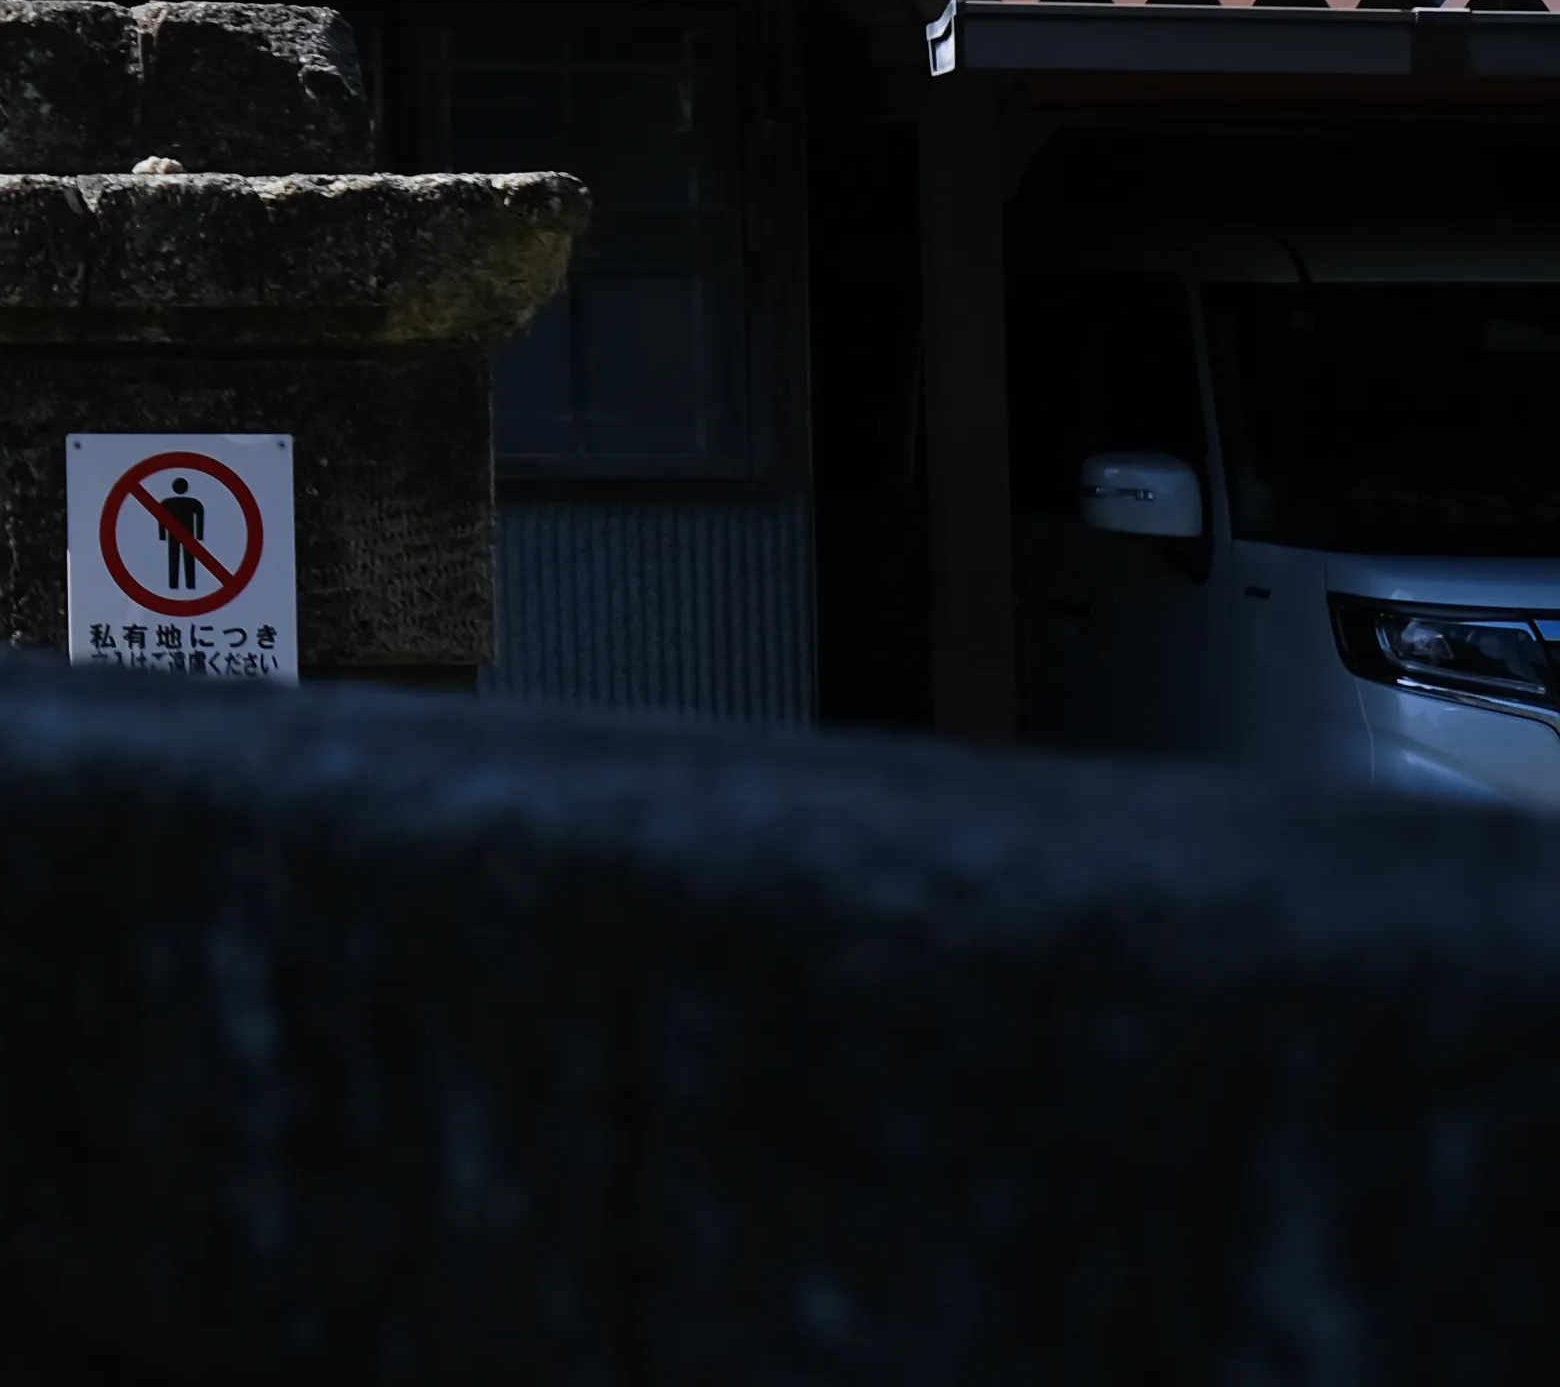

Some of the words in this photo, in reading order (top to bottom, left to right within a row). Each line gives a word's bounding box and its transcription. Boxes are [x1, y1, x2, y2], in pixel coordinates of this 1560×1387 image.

[89, 623, 278, 650] 私有地につき
